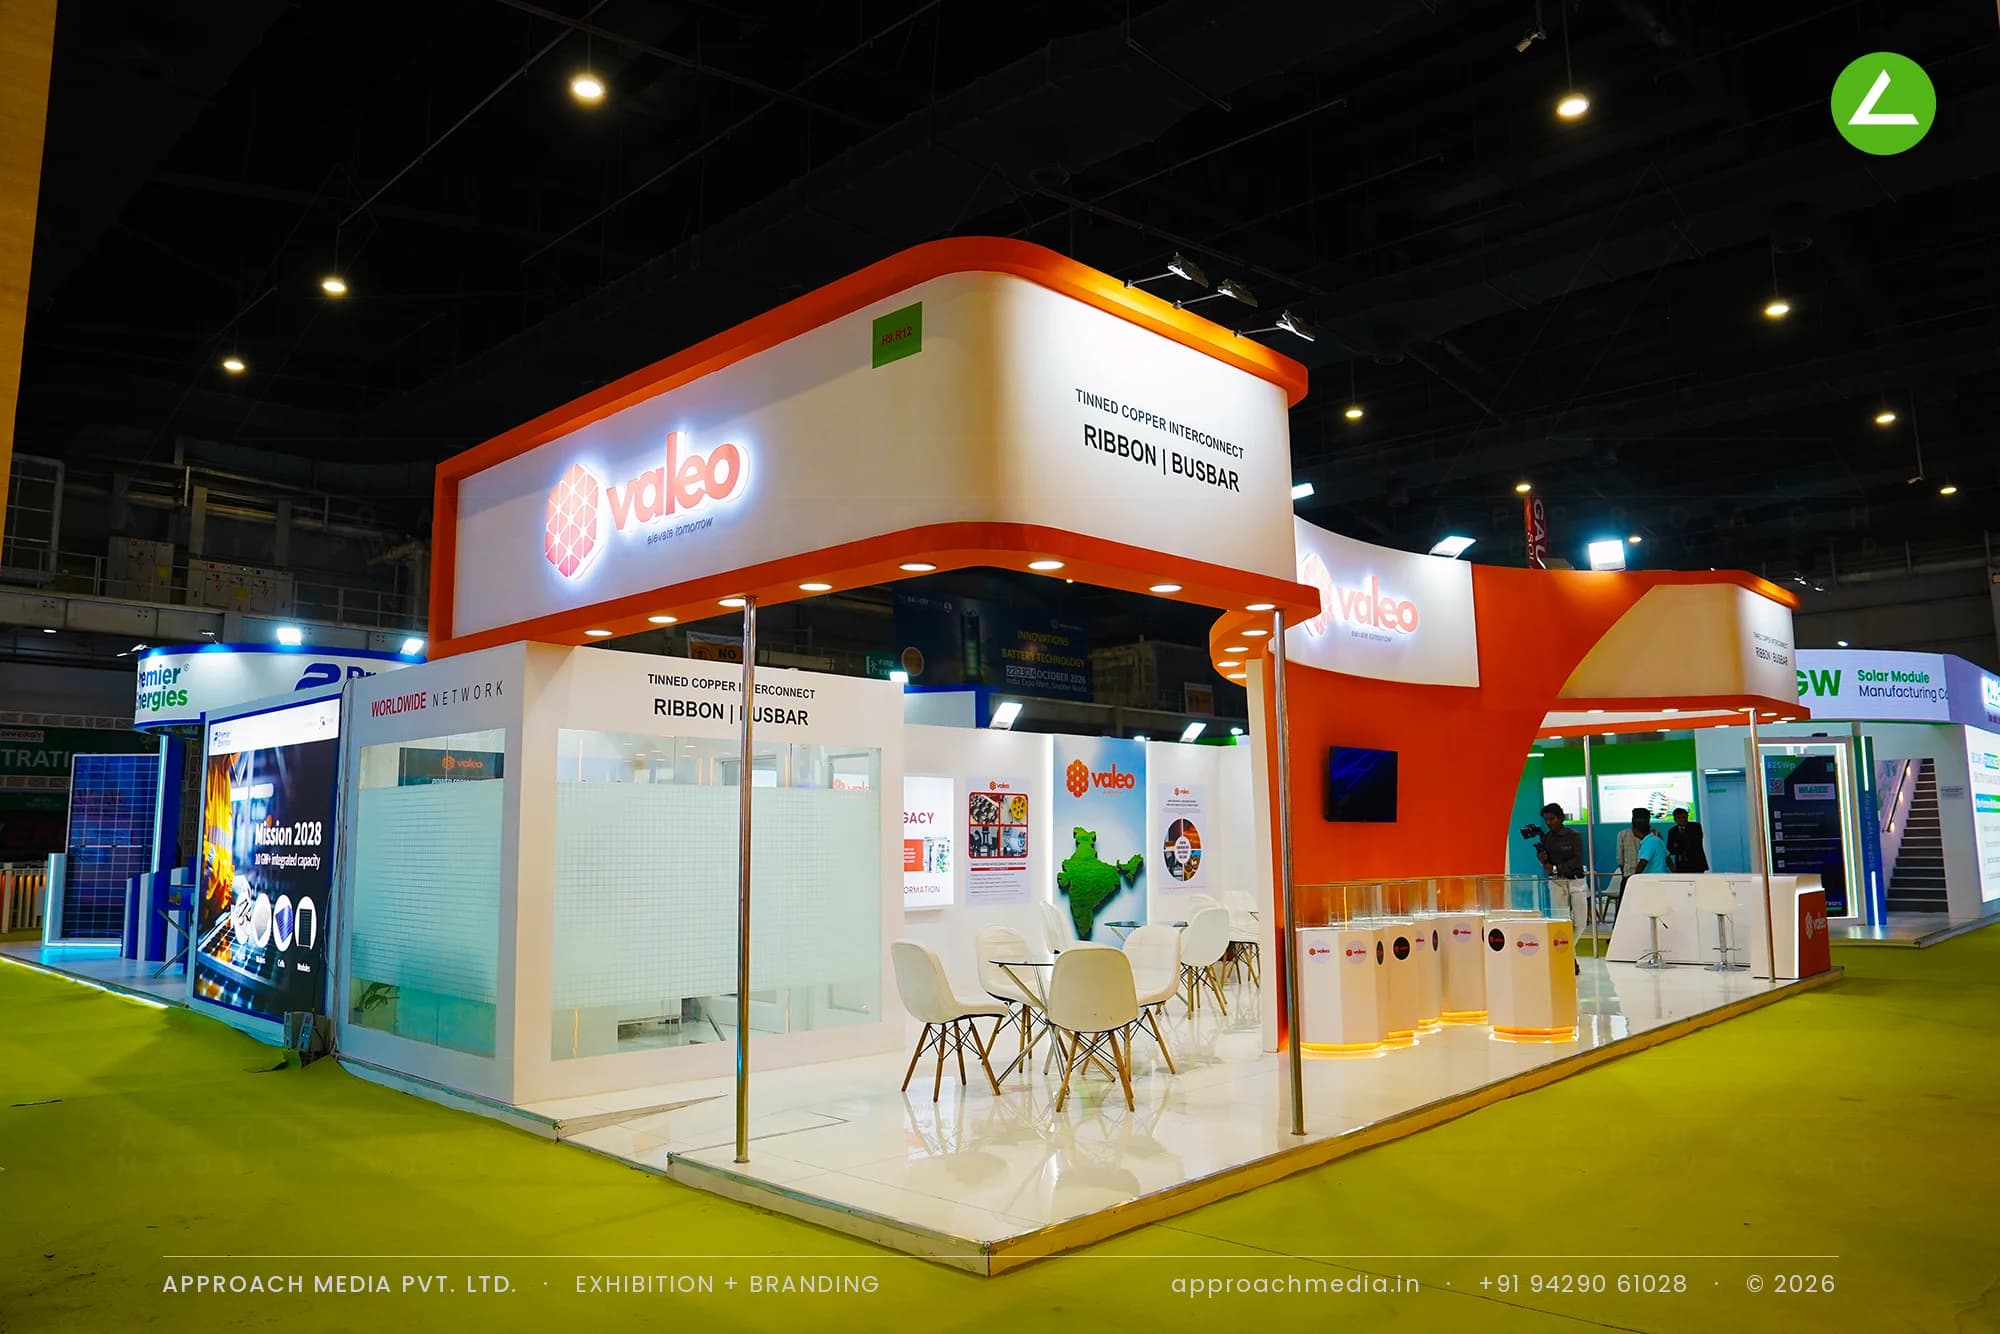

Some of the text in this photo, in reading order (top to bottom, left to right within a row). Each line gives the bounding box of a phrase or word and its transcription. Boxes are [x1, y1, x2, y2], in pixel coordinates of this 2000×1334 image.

[881, 325, 913, 345] H9.R12
[1075, 388, 1244, 459] TINNED COPPER INTERCONNECT
[1084, 423, 1156, 467] RIBBON
[1172, 452, 1240, 492] BUSBAR
[606, 431, 742, 531] valeo
[1336, 575, 1419, 633] valeo
[1017, 630, 1070, 646] INNOVATIONS
[718, 647, 736, 659] NO
[1001, 647, 1085, 668] BATTERY TECHNOLOGY
[648, 673, 816, 699] TINNED COPPER IERCONNECT
[1036, 670, 1069, 681] OCTOBER
[1857, 669, 1930, 683] Solar Module
[371, 680, 504, 718] WORLDWIDE NETWORK
[1859, 685, 1938, 703] Manufacturing
[654, 698, 724, 720] RIBBON
[740, 706, 809, 726] USBAR
[1091, 763, 1136, 790] valeo
[255, 819, 322, 846] Mission 2028
[271, 853, 297, 870] integrated
[298, 853, 321, 871] capacity
